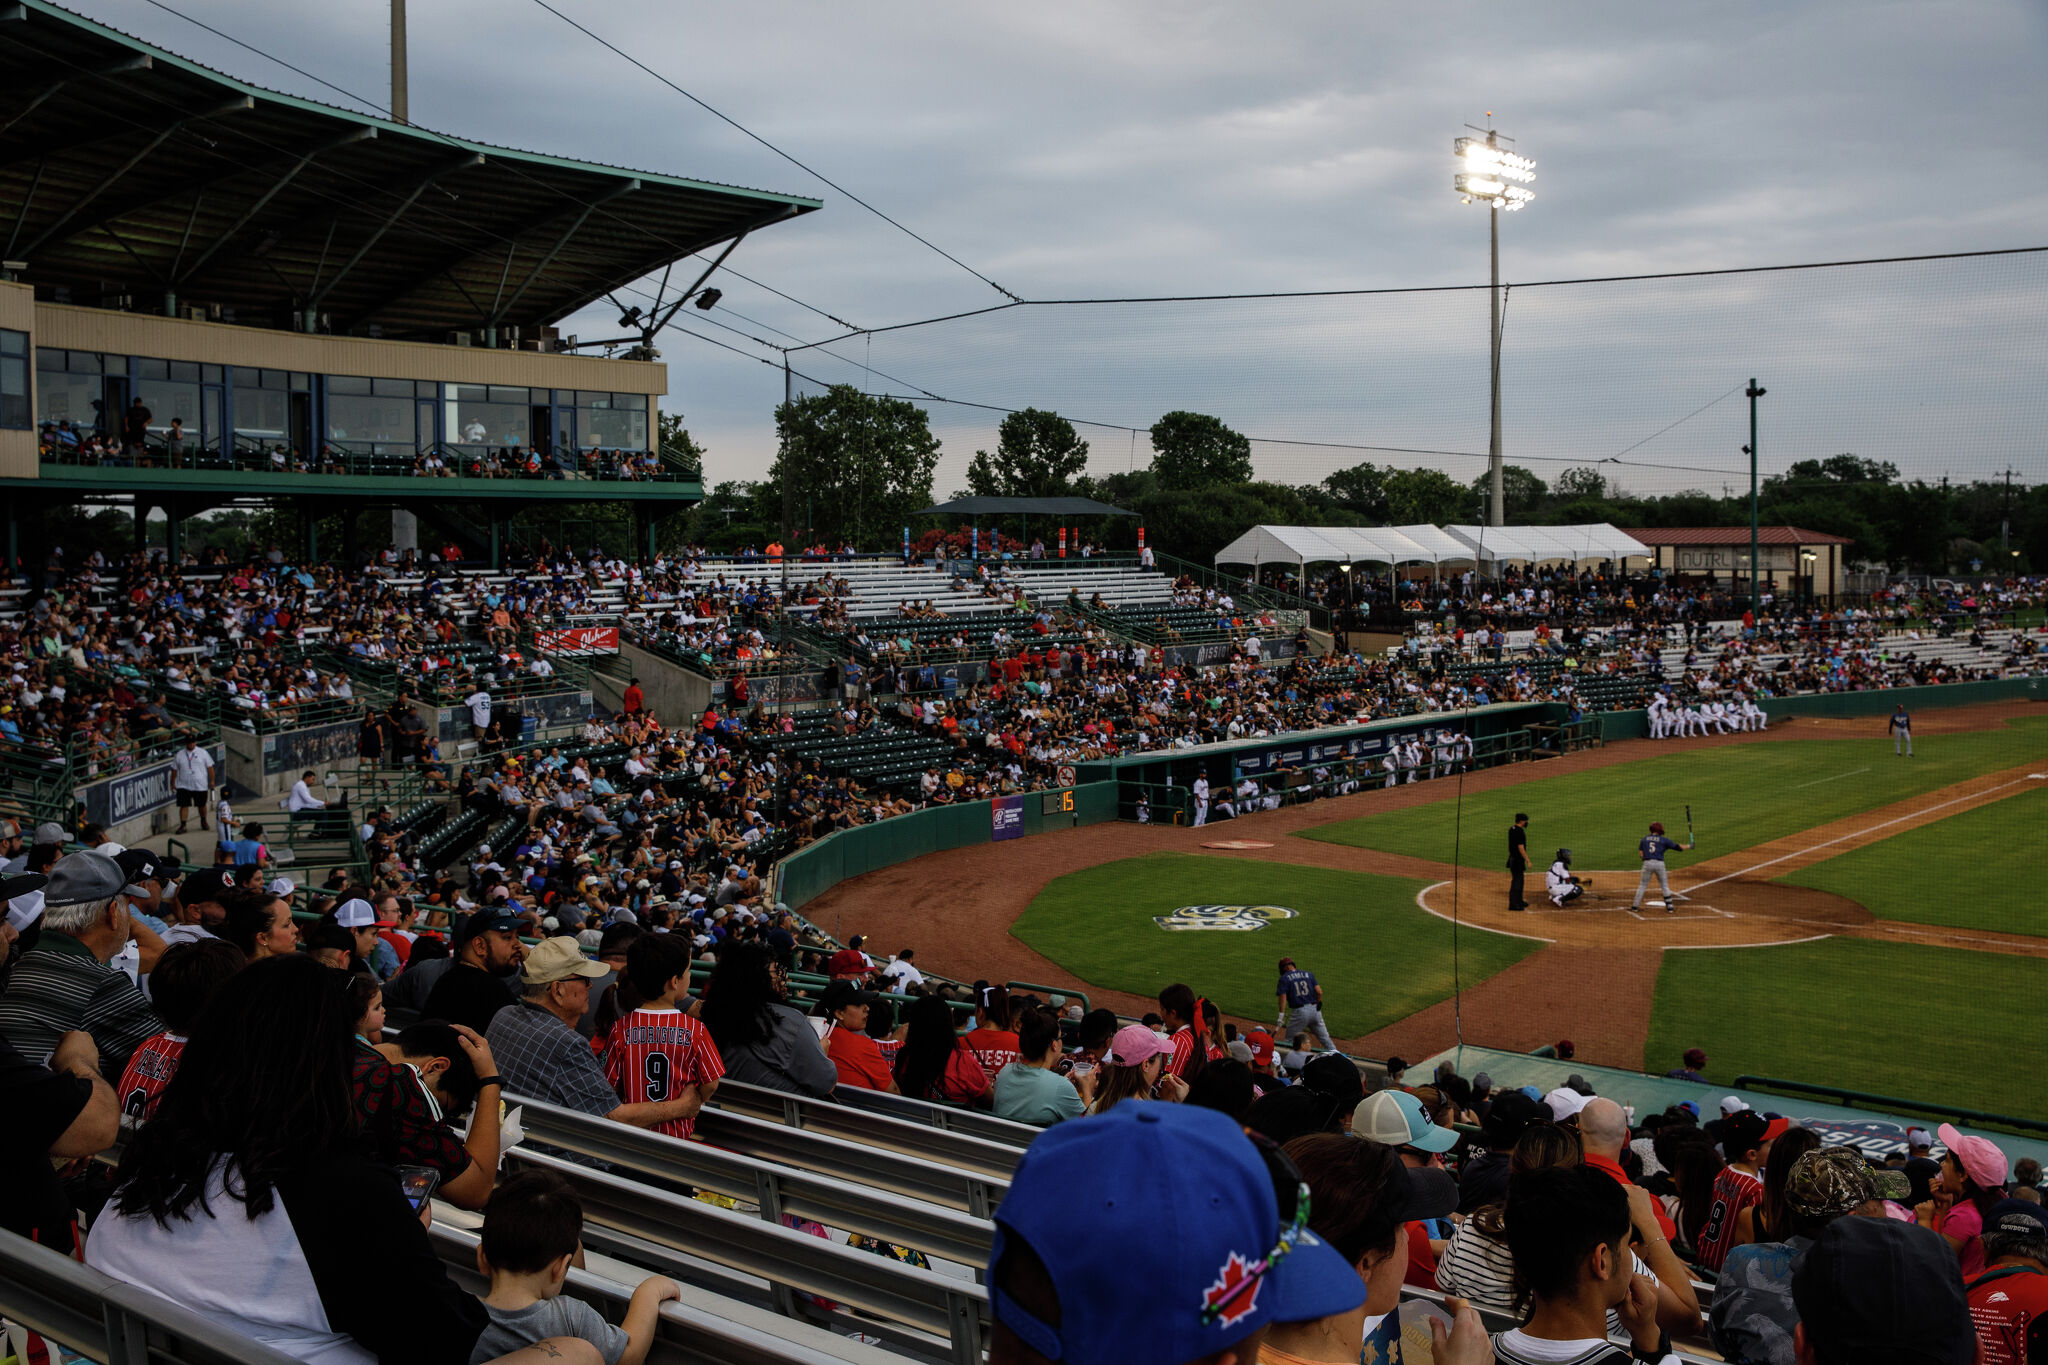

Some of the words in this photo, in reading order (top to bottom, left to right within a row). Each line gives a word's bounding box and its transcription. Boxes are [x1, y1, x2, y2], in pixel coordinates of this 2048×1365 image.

[1063, 790, 1074, 811] 15
[1649, 841, 1657, 854] 5
[1294, 980, 1309, 997] 13
[626, 1025, 692, 1046] RODRIGUEZ
[645, 1051, 670, 1102] 9
[1704, 1199, 1727, 1242] 8
